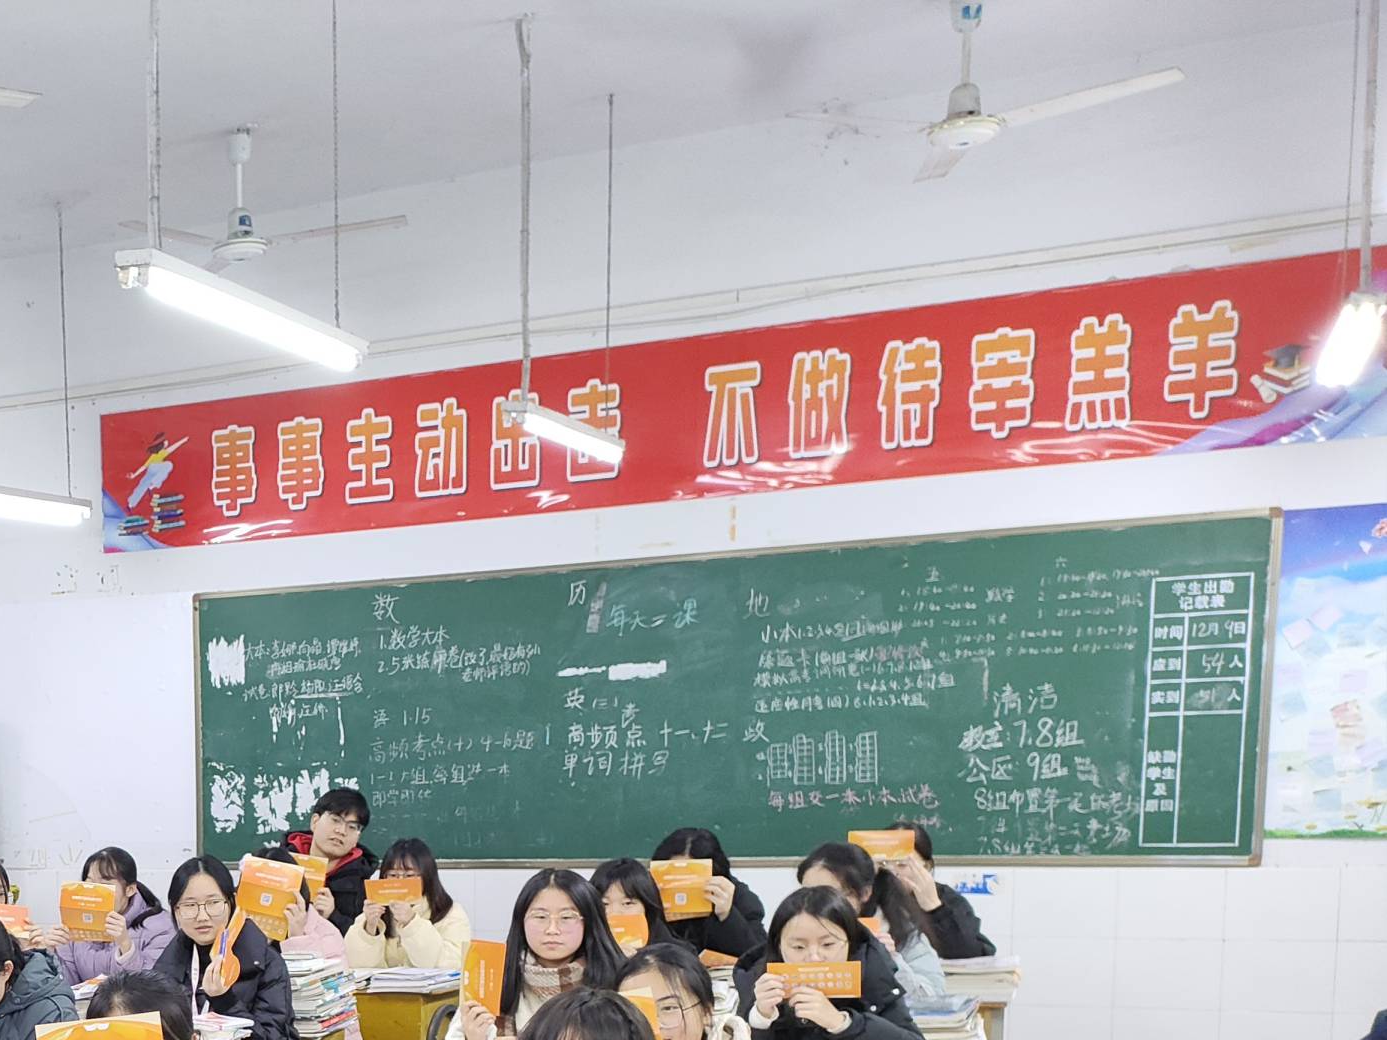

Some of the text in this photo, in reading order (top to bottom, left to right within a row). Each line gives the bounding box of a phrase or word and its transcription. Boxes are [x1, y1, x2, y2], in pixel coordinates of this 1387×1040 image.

[210, 298, 1241, 518] 事事主动出击 不做待宰羔羊
[568, 580, 588, 606] 历
[1171, 579, 1235, 596] 学生出勤
[372, 593, 401, 624] 数
[1178, 594, 1226, 611] 记载表
[1153, 624, 1184, 641] 时间
[1152, 655, 1182, 672] 应到
[564, 687, 586, 711] 英
[1150, 688, 1181, 705] 实到
[742, 719, 770, 743] 政
[1146, 766, 1176, 781] 学生
